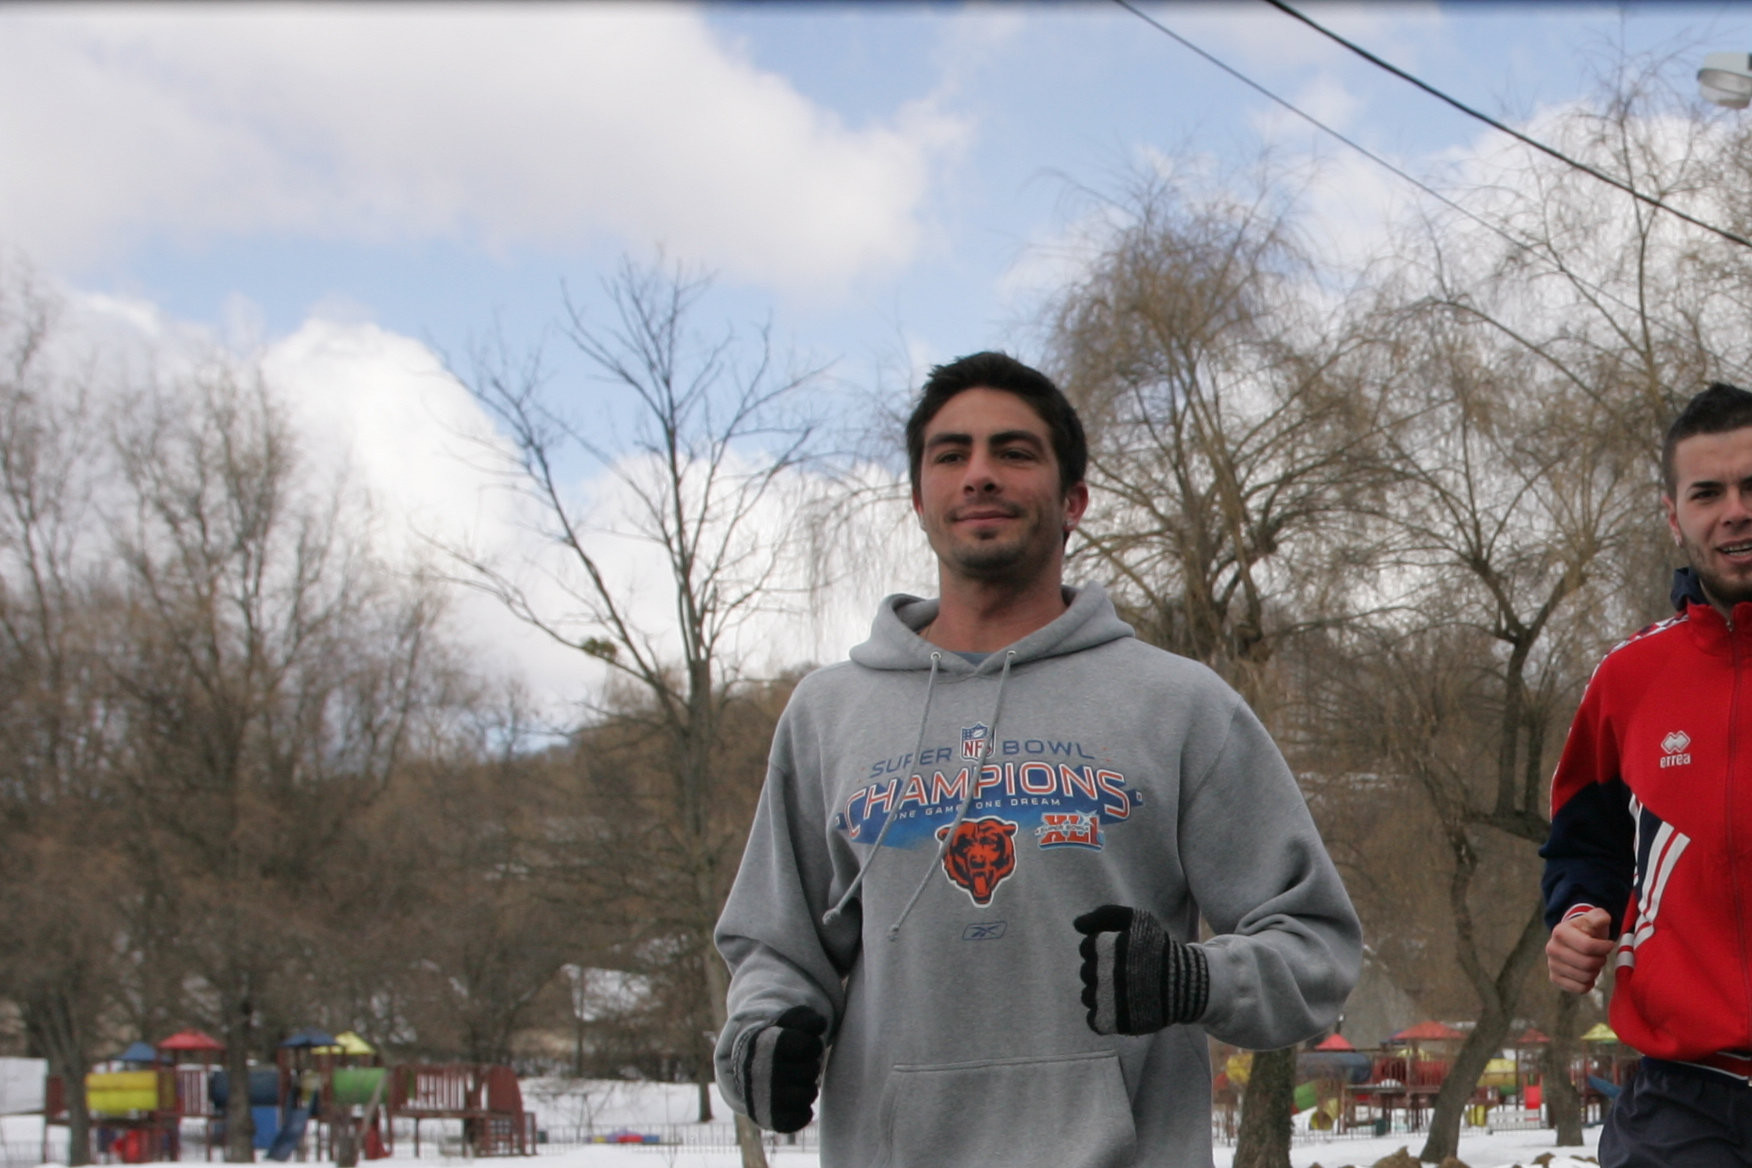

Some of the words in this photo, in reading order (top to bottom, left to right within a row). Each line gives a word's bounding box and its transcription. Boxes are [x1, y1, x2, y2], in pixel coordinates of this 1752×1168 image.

[1002, 740, 1096, 760] BOWL
[844, 761, 1131, 839] CHAMPIONS
[975, 799, 1002, 810] ONE
[1010, 797, 1061, 807] DREAM
